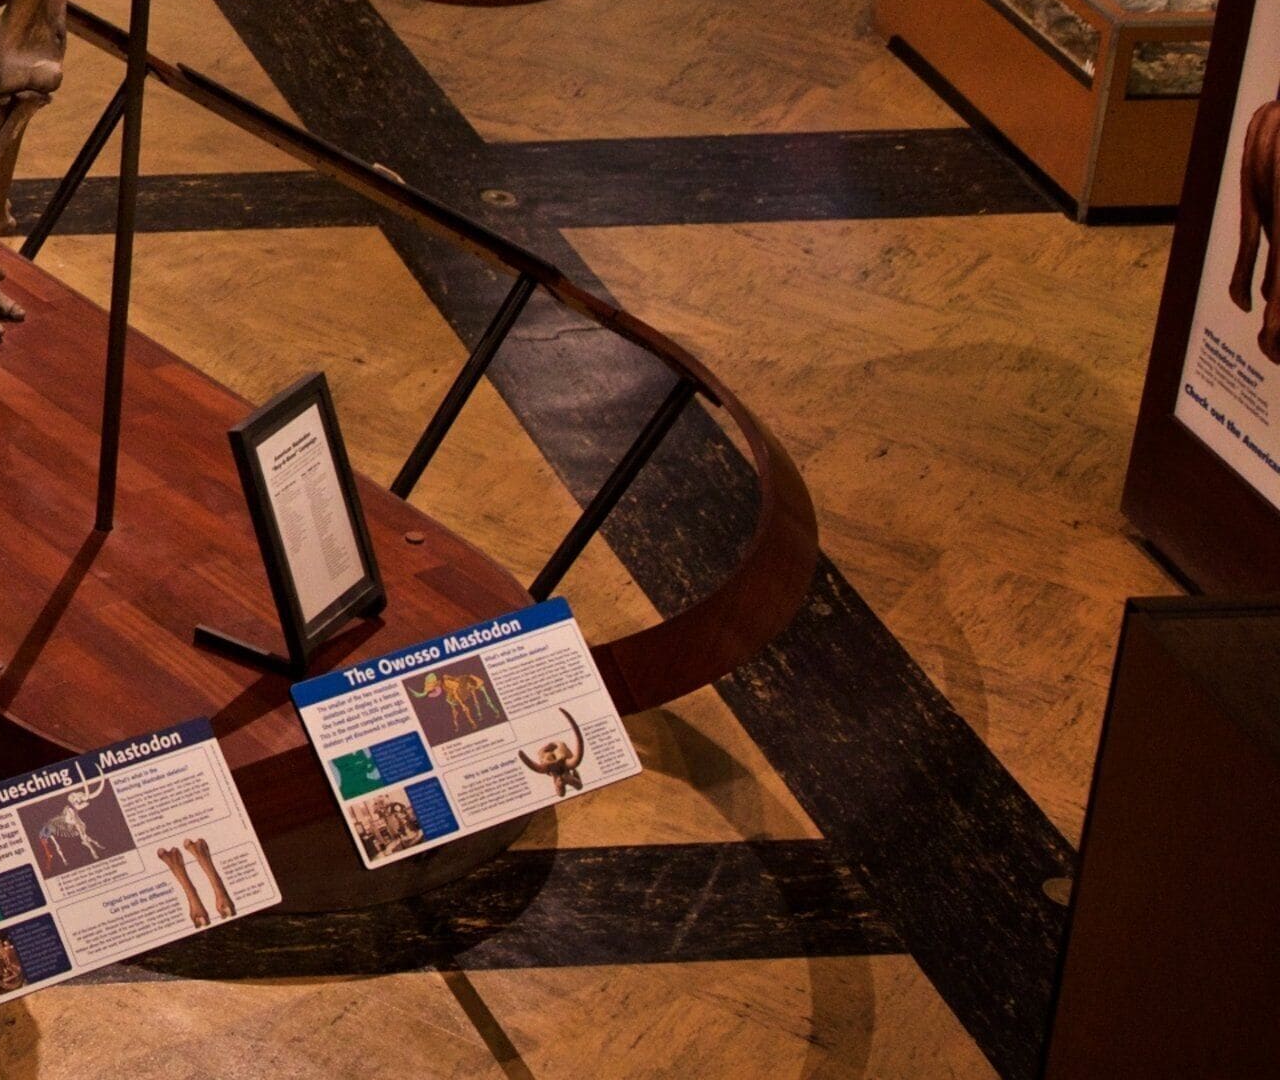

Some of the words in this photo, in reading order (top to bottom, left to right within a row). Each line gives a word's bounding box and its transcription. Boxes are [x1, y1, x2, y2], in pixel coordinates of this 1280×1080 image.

[1185, 383, 1209, 410] Check
[1210, 408, 1225, 425] out
[1227, 420, 1241, 439] the
[343, 668, 376, 686] The
[377, 646, 441, 676] Owosso
[443, 619, 522, 654] Mastodon
[98, 731, 182, 769] Mastodon
